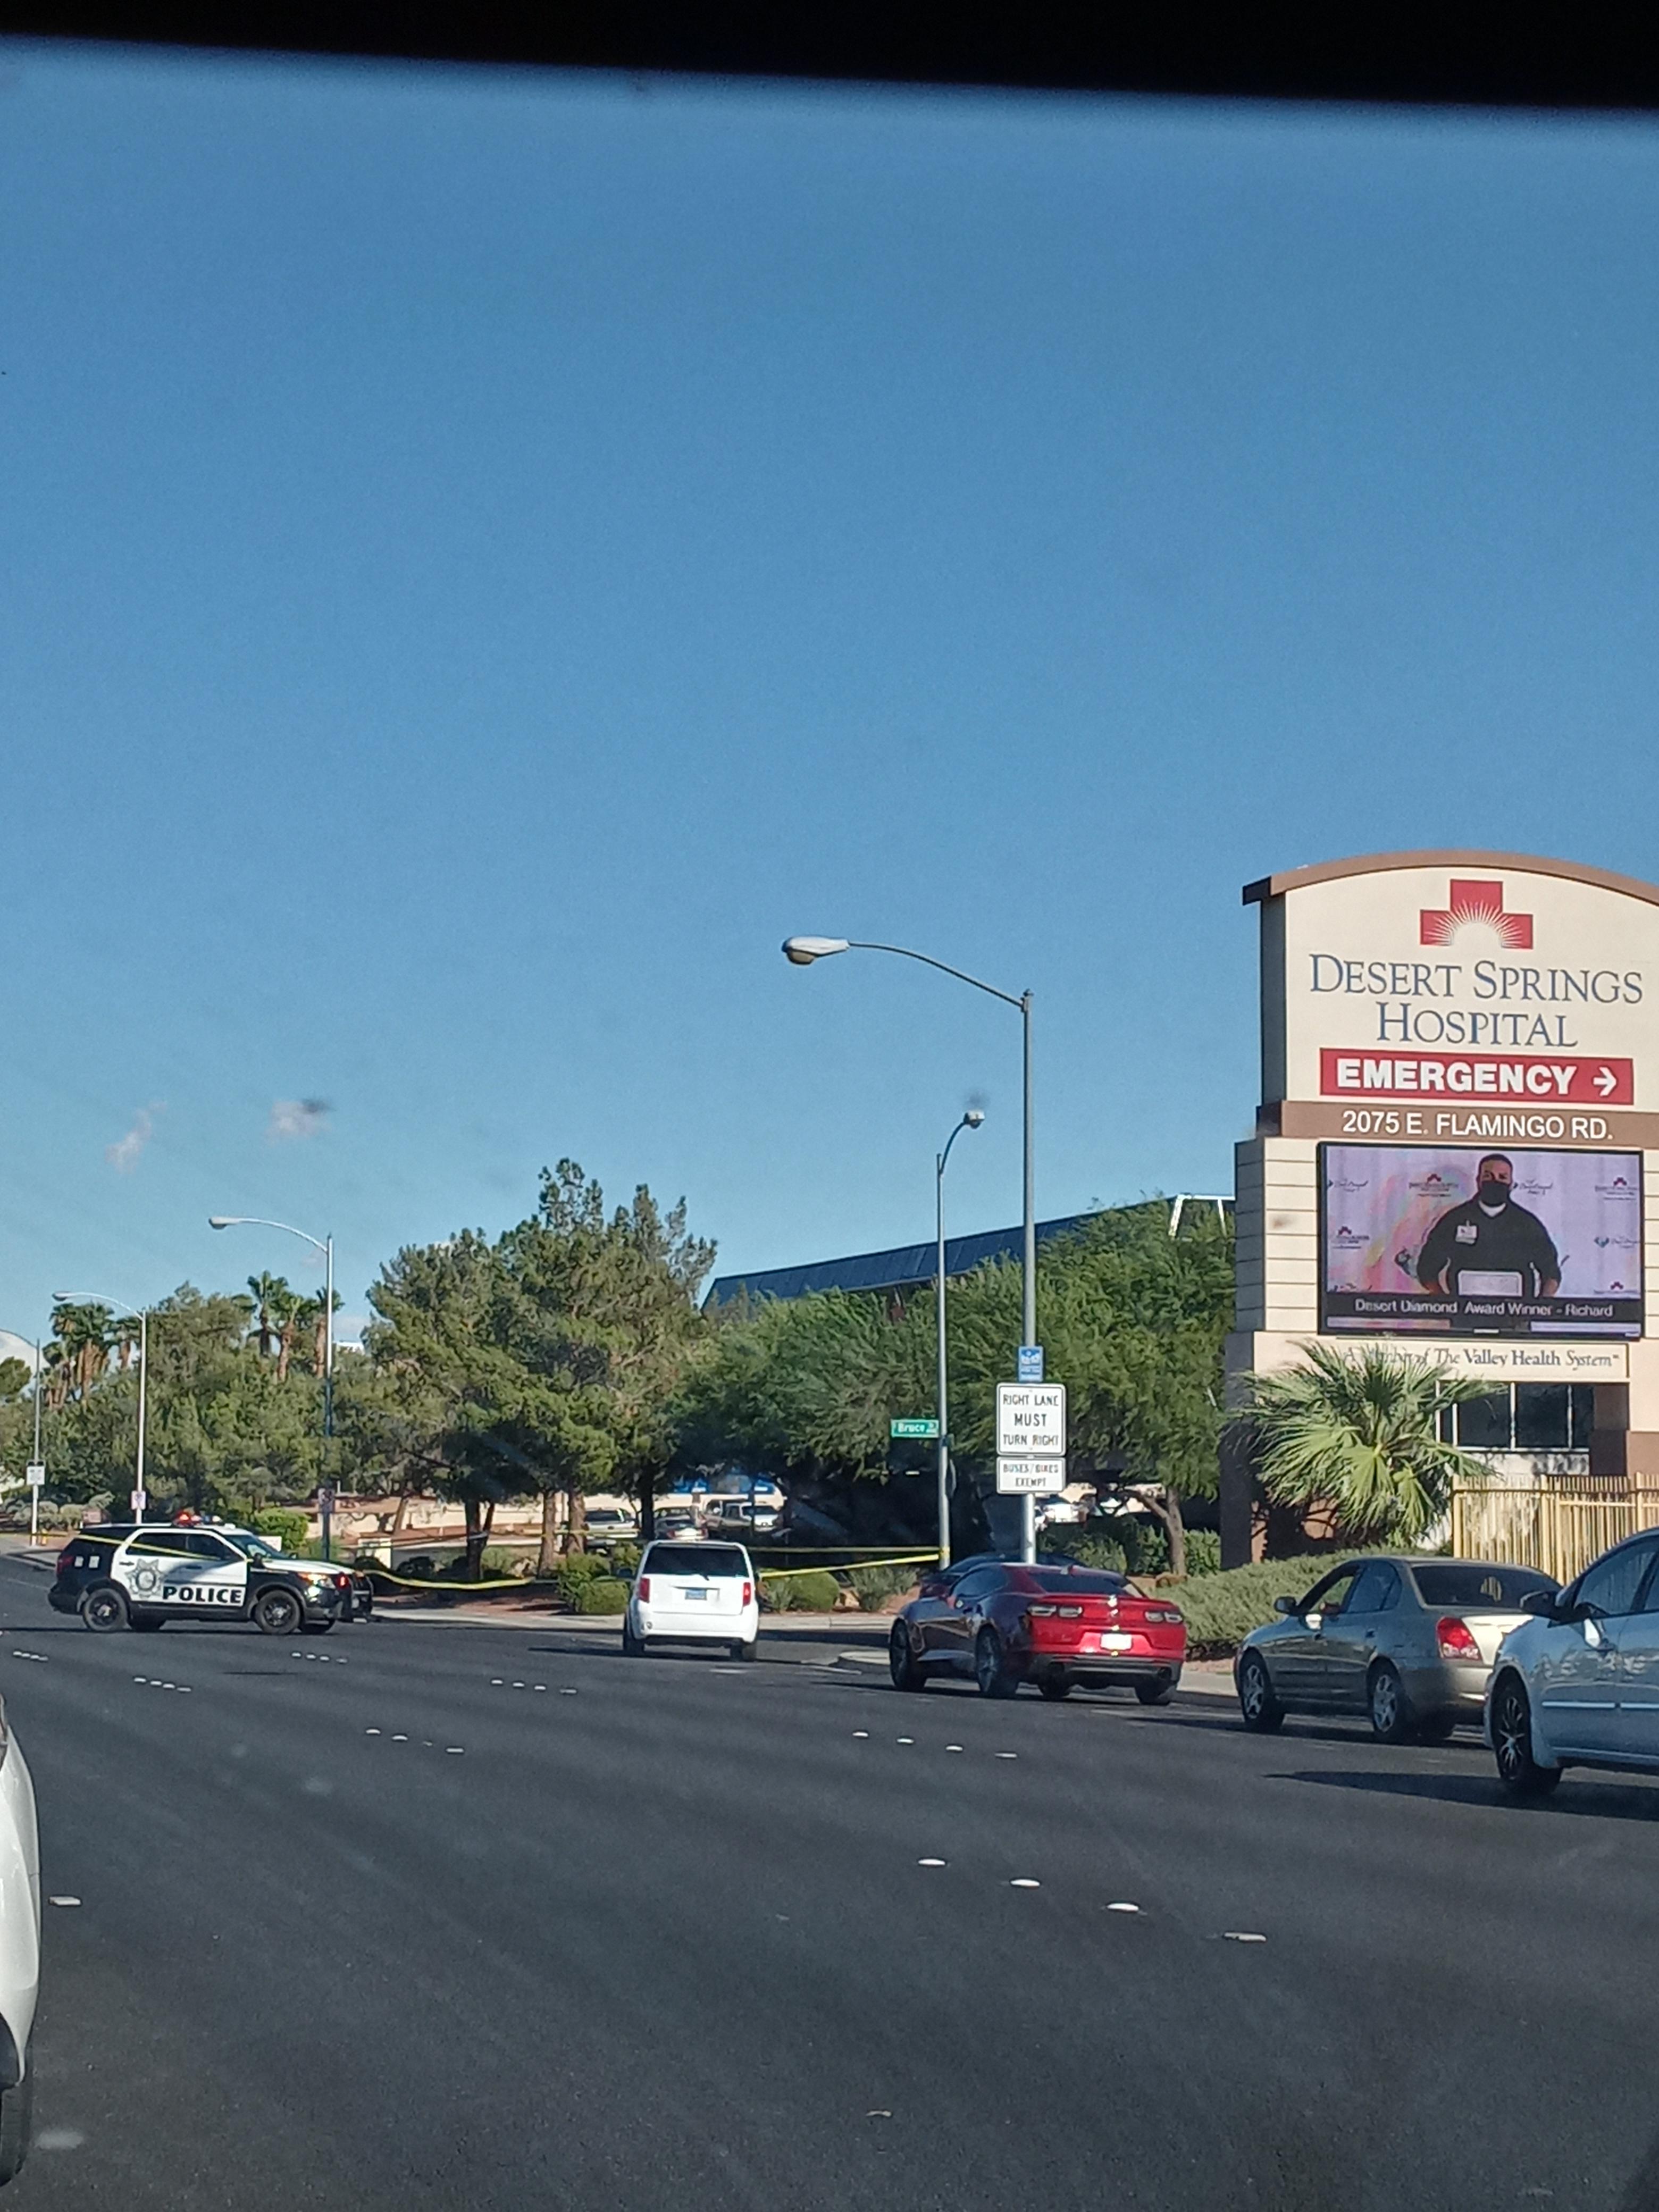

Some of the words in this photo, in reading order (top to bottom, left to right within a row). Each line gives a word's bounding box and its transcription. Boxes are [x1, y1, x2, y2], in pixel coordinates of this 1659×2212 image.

[1309, 953, 1462, 998] DESERT
[1473, 960, 1643, 1004] SPRINGS
[1376, 1001, 1578, 1048] HOSPITAL
[1336, 1058, 1577, 1095] EMERGENCY
[1343, 1110, 1400, 1135] 2075
[1406, 1112, 1429, 1135] E.
[1436, 1113, 1564, 1139] FLAMINGO
[1571, 1117, 1613, 1139] RD.
[1355, 1299, 1397, 1312] Desert
[1401, 1299, 1458, 1313] Diamond
[1464, 1301, 1505, 1315] Award
[1507, 1303, 1552, 1316] Winner
[1565, 1304, 1613, 1317] Richard
[1434, 1347, 1460, 1364] The
[1463, 1348, 1507, 1367] Valley
[1511, 1350, 1561, 1366] Health
[1003, 1394, 1029, 1405] RIGHT
[1034, 1395, 1059, 1406] LANE
[898, 1422, 925, 1432] Bruce
[1014, 1413, 1047, 1427] MUST
[1003, 1434, 1027, 1446] TURN
[1032, 1434, 1059, 1446] RIGHT
[1015, 1477, 1046, 1487] EXEMPT
[163, 1586, 242, 1603] POLICE
